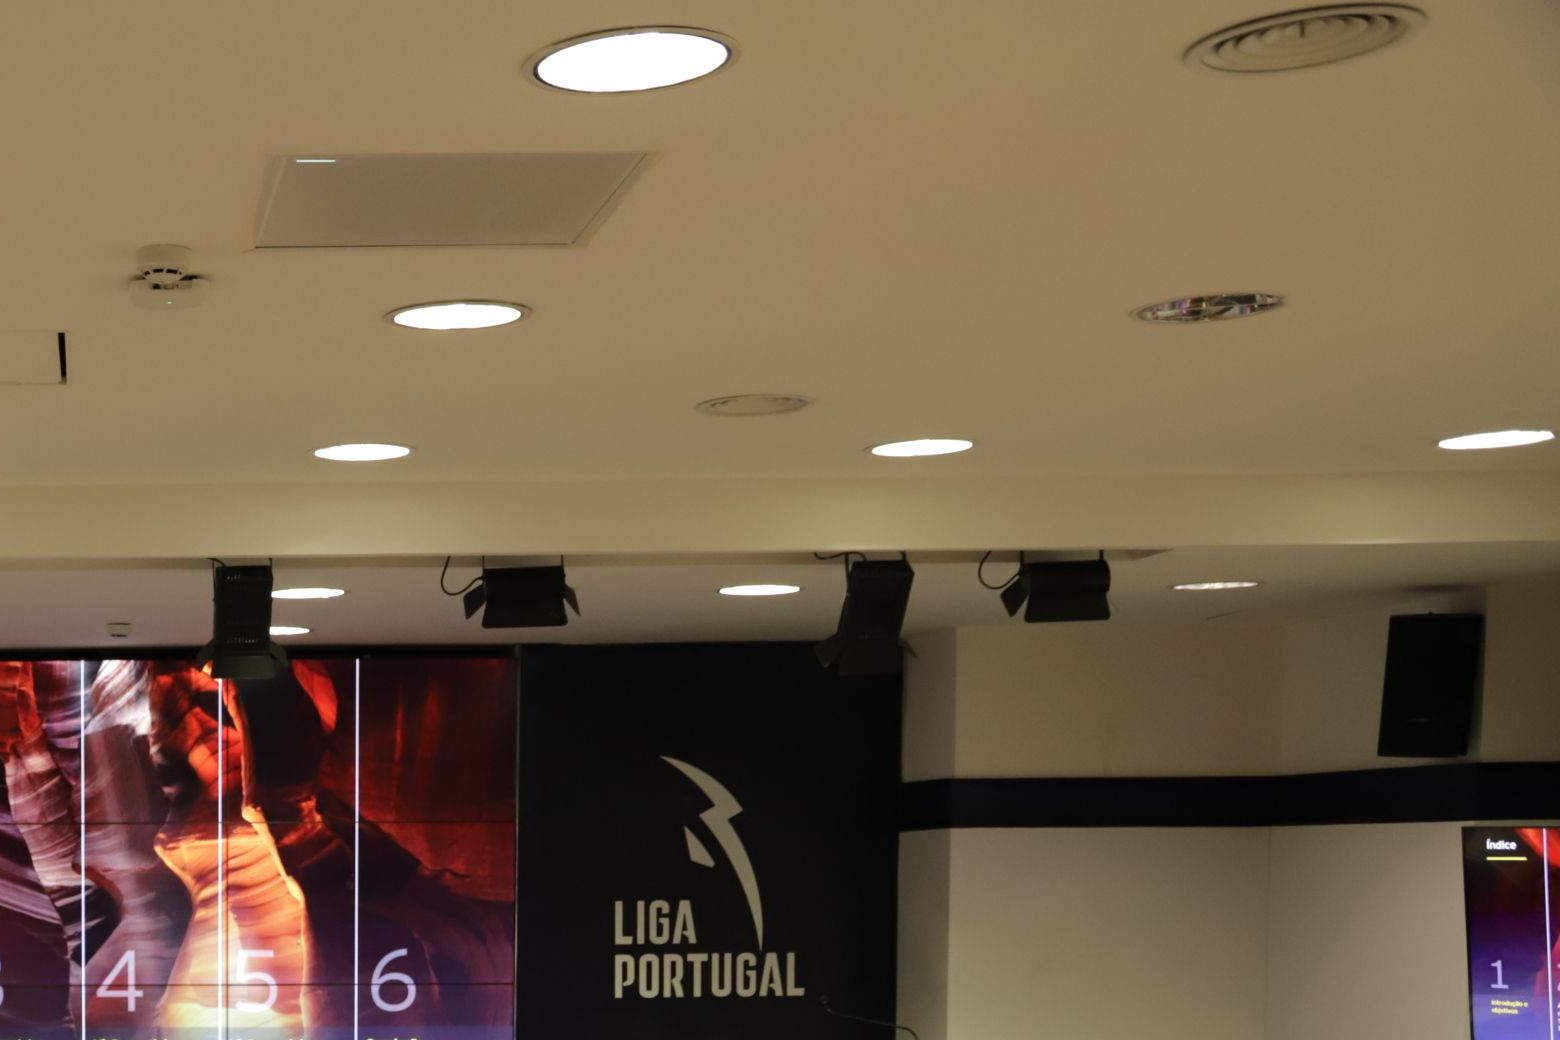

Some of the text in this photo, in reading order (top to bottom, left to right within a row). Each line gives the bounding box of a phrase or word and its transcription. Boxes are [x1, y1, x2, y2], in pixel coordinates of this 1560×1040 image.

[1486, 838, 1517, 851] Índice
[614, 899, 697, 945] LIGA
[96, 949, 144, 1013] 4
[235, 949, 278, 1013] 5
[370, 948, 417, 1013] 6
[614, 952, 806, 999] PORTUGAL
[1490, 959, 1509, 989] 1
